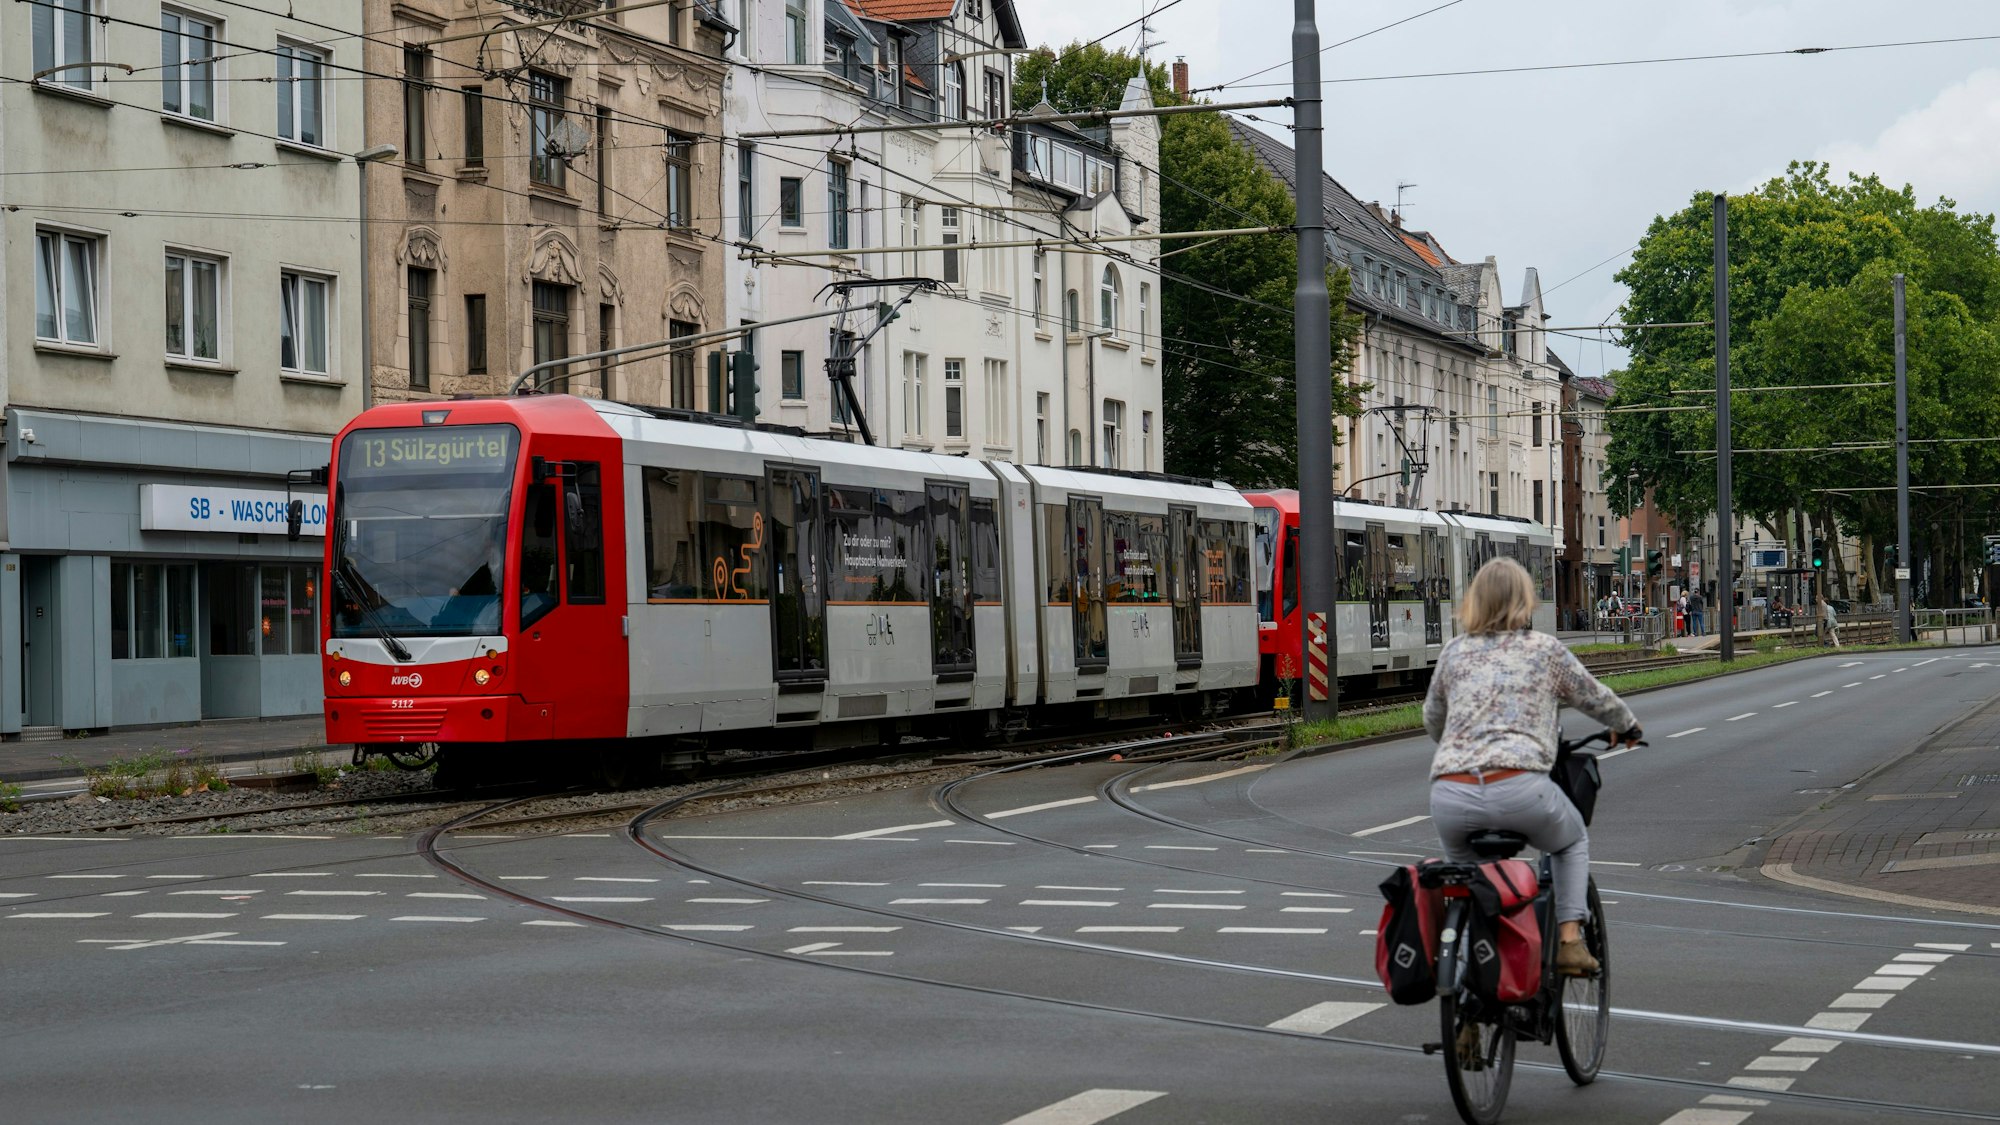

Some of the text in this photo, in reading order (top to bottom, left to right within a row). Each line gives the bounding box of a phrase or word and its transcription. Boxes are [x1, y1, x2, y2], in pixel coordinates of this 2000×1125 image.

[364, 434, 506, 467] 13 Sülzgürtel
[190, 497, 210, 519] SB
[231, 500, 328, 525] WASCHSLON
[843, 533, 851, 547] Zu
[860, 534, 872, 548] oder
[873, 538, 879, 548] zu
[880, 536, 891, 549] mir?
[844, 553, 907, 569] Hauptsache Nahverkehr.
[391, 676, 408, 685] KVB
[391, 699, 413, 709] 5112
